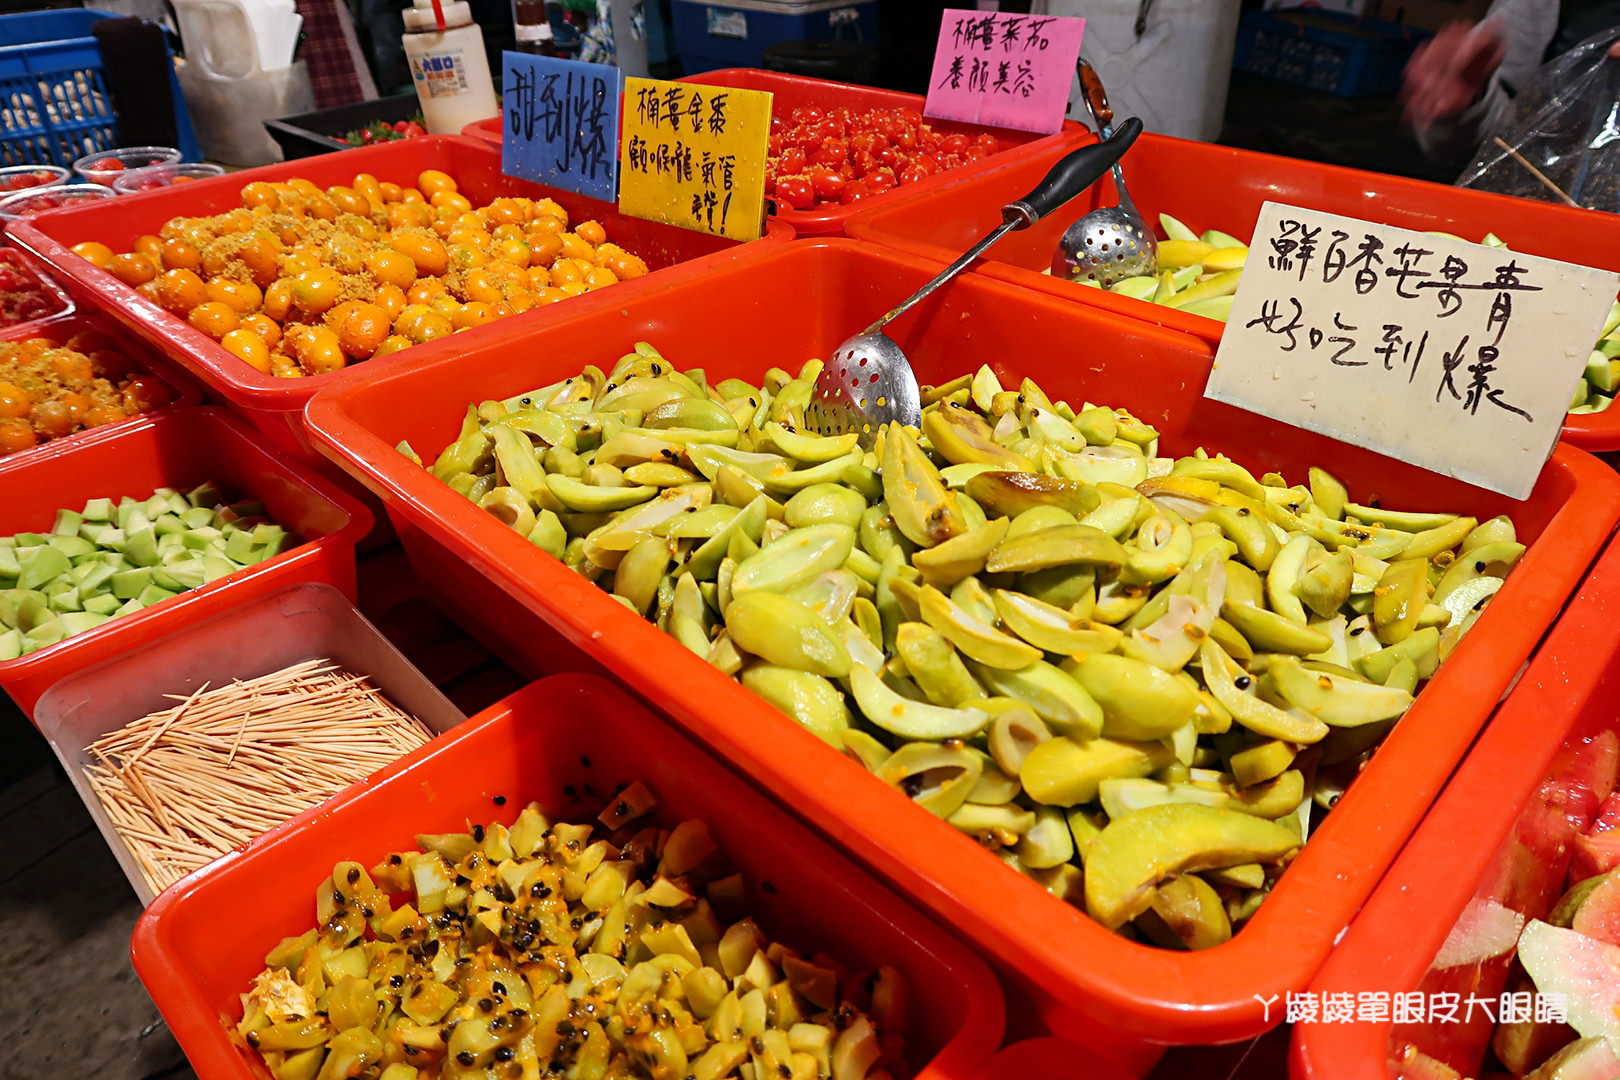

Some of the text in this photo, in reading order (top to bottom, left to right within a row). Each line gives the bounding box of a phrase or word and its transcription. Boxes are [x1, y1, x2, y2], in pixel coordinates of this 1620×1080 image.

[505, 66, 612, 181] 甜到爆
[938, 55, 1035, 97] 養顏美容
[1268, 219, 1544, 345] 鮮百香芒果青
[1246, 297, 1534, 424] 好吃到爆
